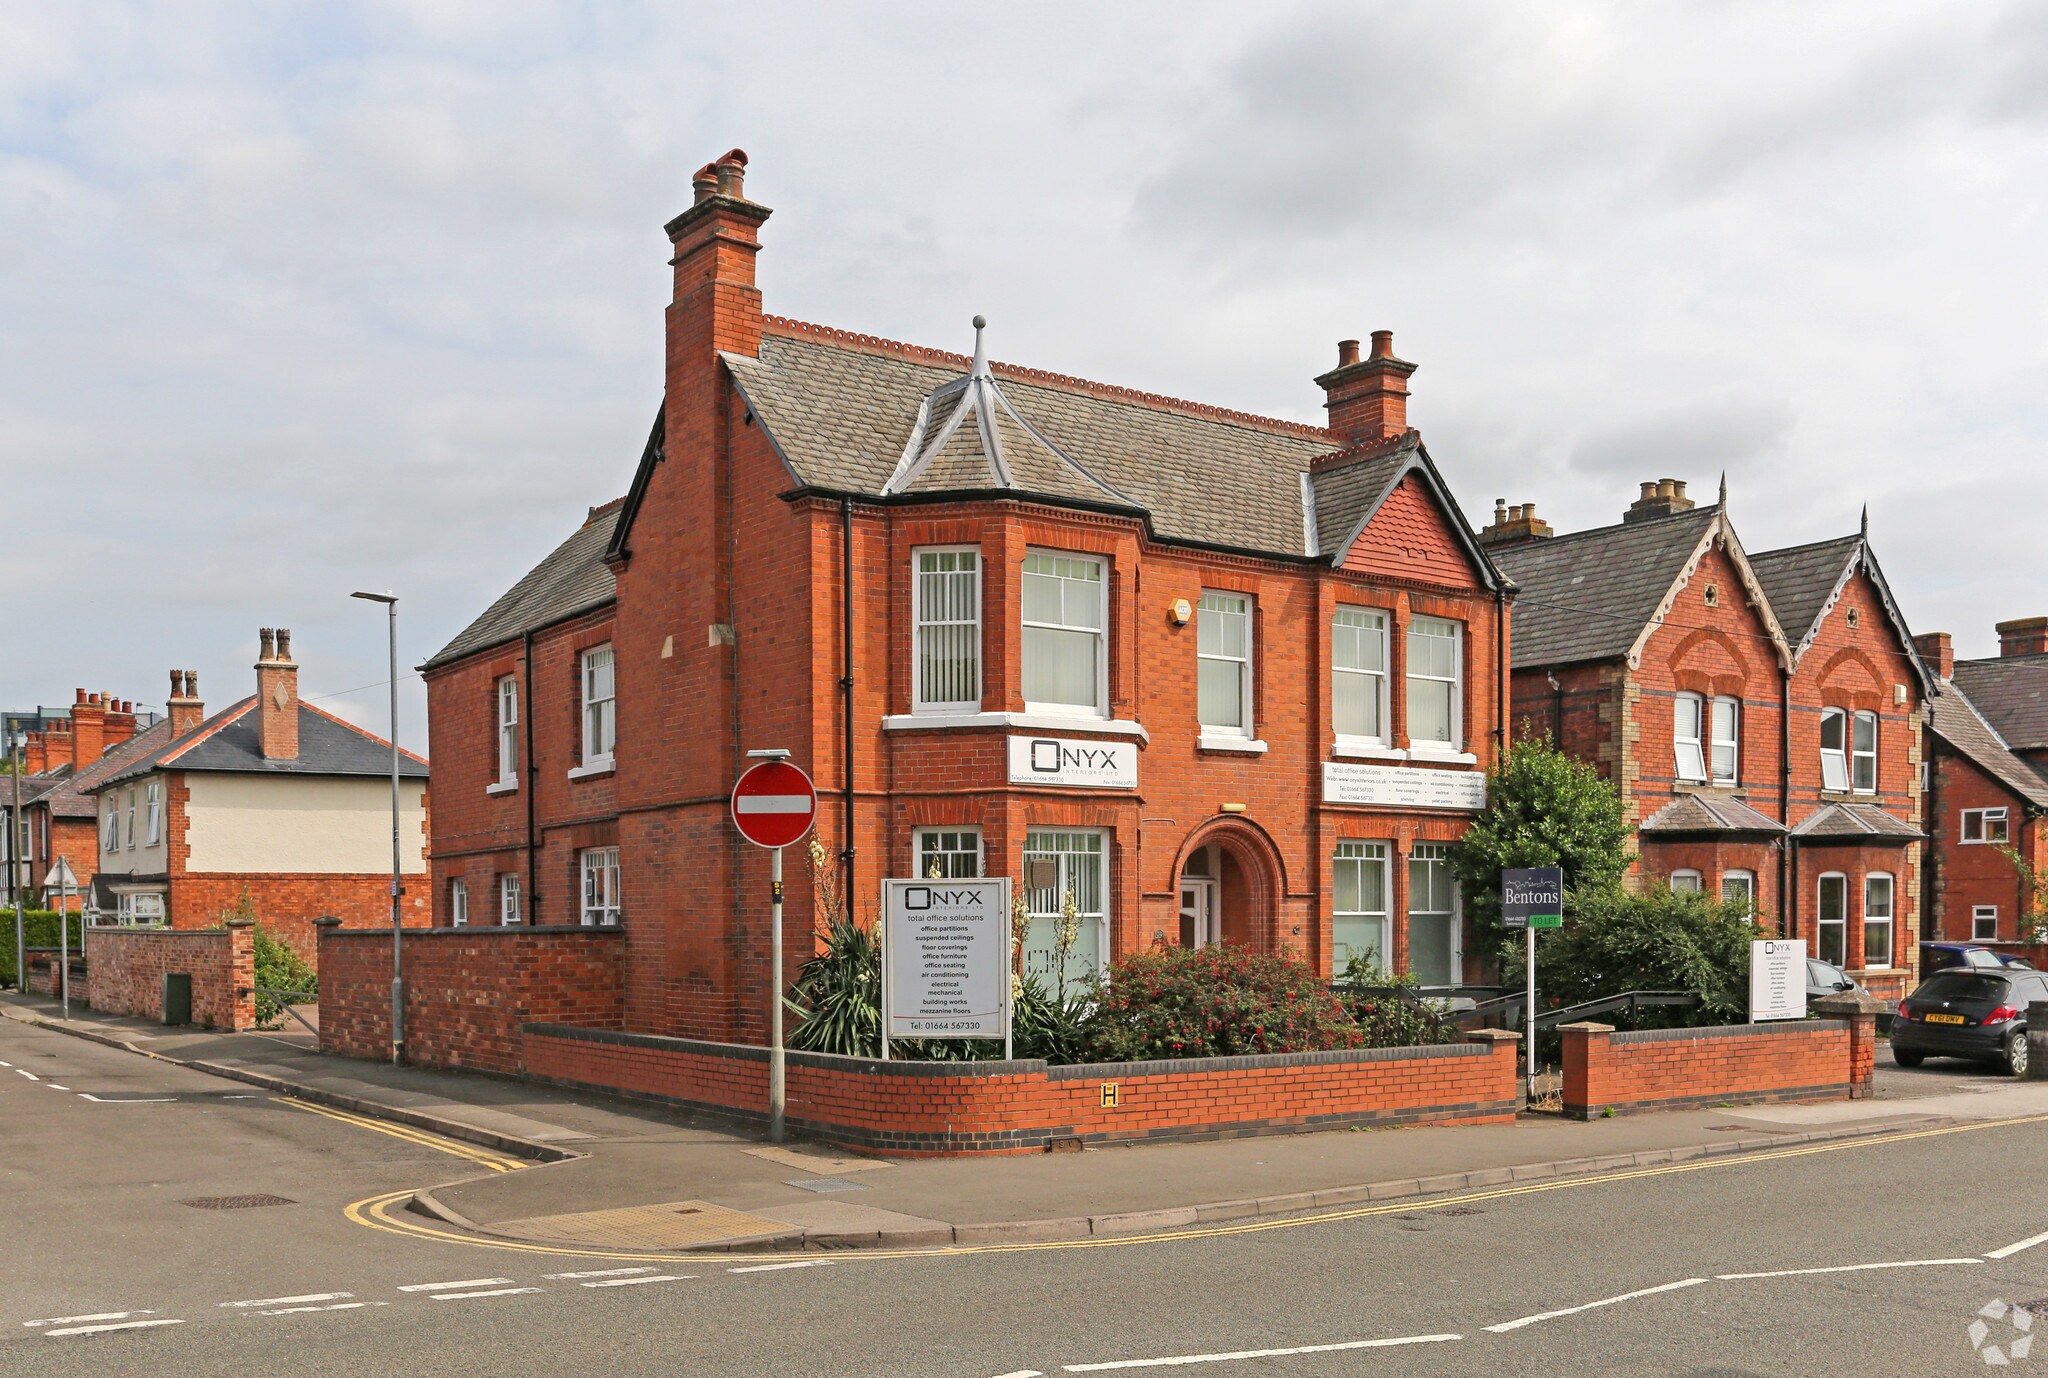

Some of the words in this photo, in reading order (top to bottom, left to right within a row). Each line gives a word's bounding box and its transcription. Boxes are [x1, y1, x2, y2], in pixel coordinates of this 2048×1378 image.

[1031, 740, 1117, 772] ONYX
[905, 887, 982, 910] ONYX
[1506, 889, 1558, 904] Bentons
[1766, 942, 1790, 954] ONYX
[1104, 1086, 1116, 1105] H
